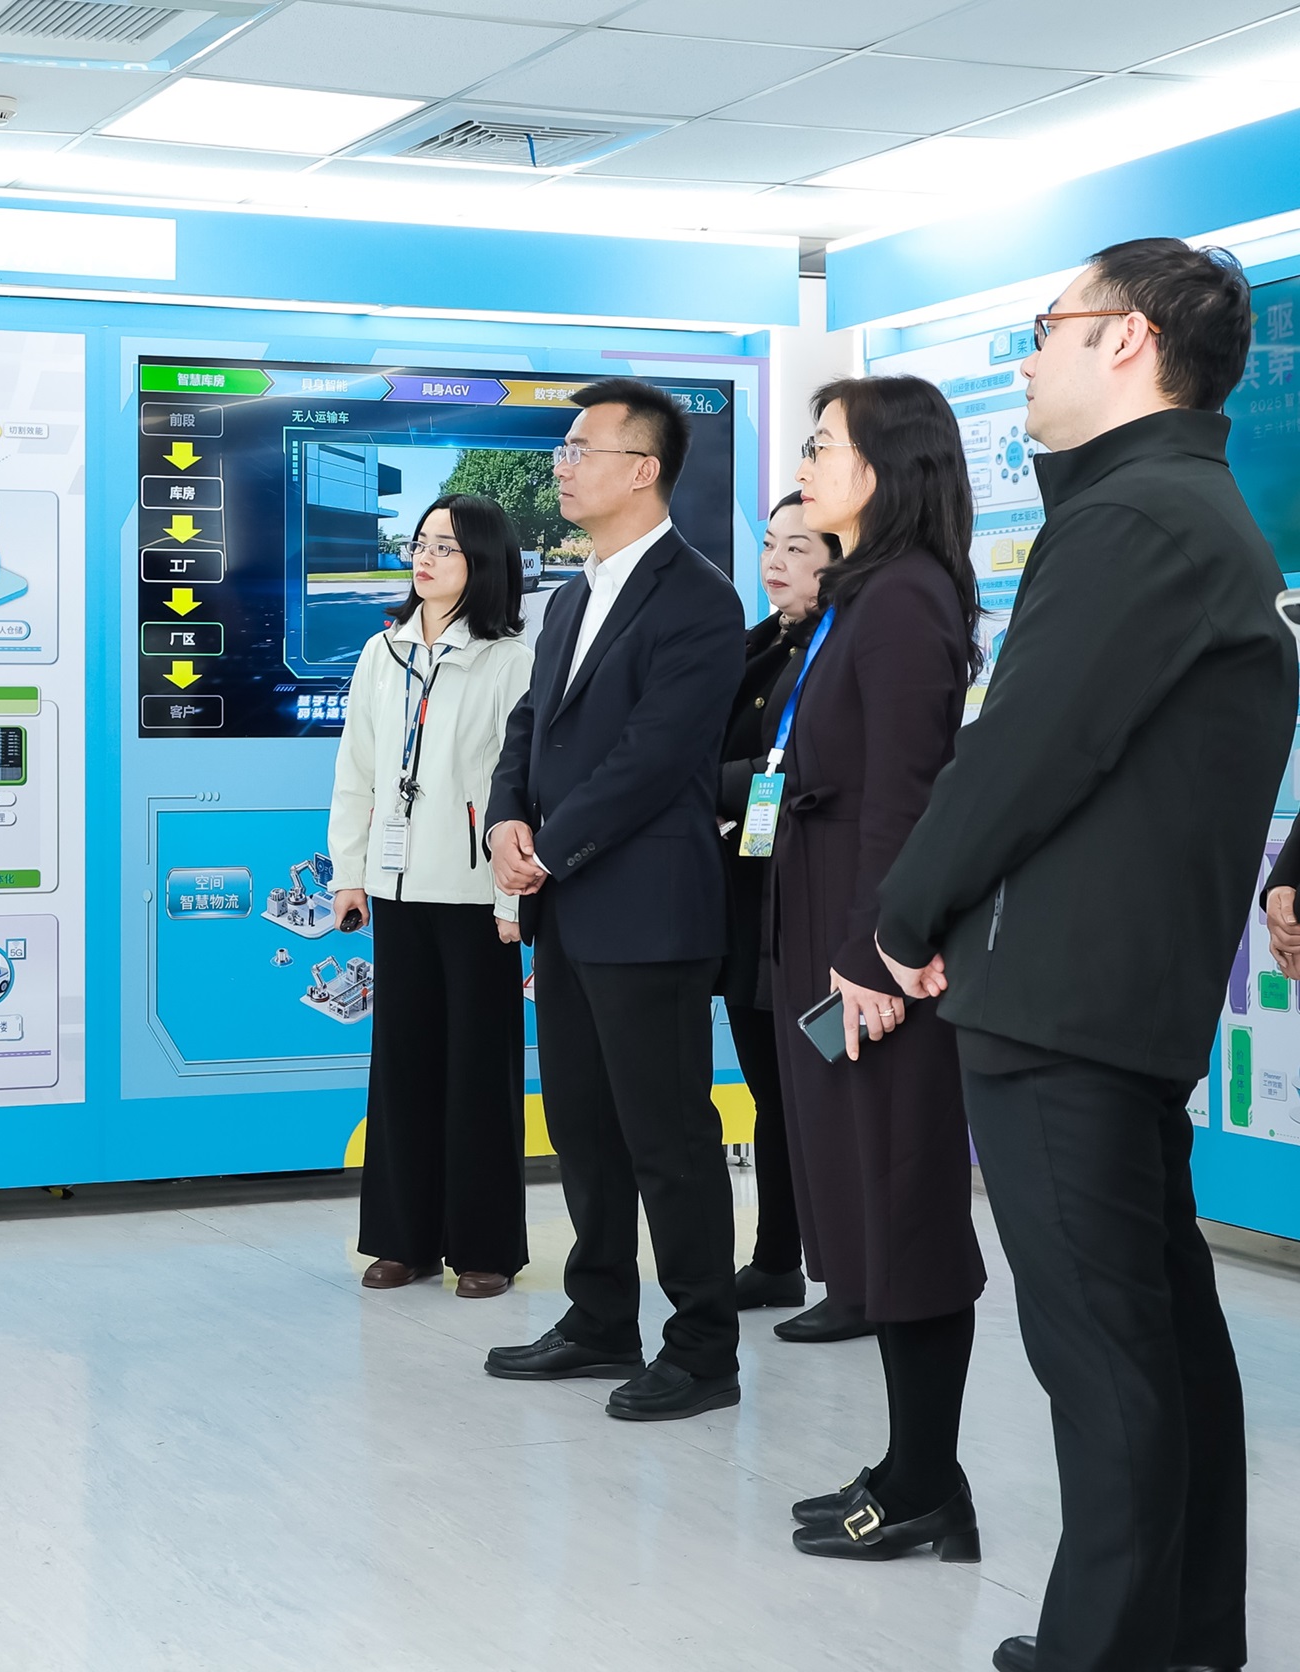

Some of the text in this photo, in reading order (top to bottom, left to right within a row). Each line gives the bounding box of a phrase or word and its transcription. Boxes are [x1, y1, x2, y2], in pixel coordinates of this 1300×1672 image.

[177, 372, 225, 388] 智慧库房
[301, 378, 348, 393] 具身智能
[421, 383, 471, 397] 具身AGV
[169, 412, 196, 428] 前段
[292, 410, 350, 424] 无人运输车
[9, 425, 44, 436] 切割效能
[169, 486, 196, 501] 库房
[170, 559, 196, 573] 工厂
[170, 632, 196, 646] 厂区
[169, 705, 196, 719] 客户
[195, 875, 224, 890] 空间
[180, 893, 240, 911] 智慧物流
[10, 949, 23, 957] 5G
